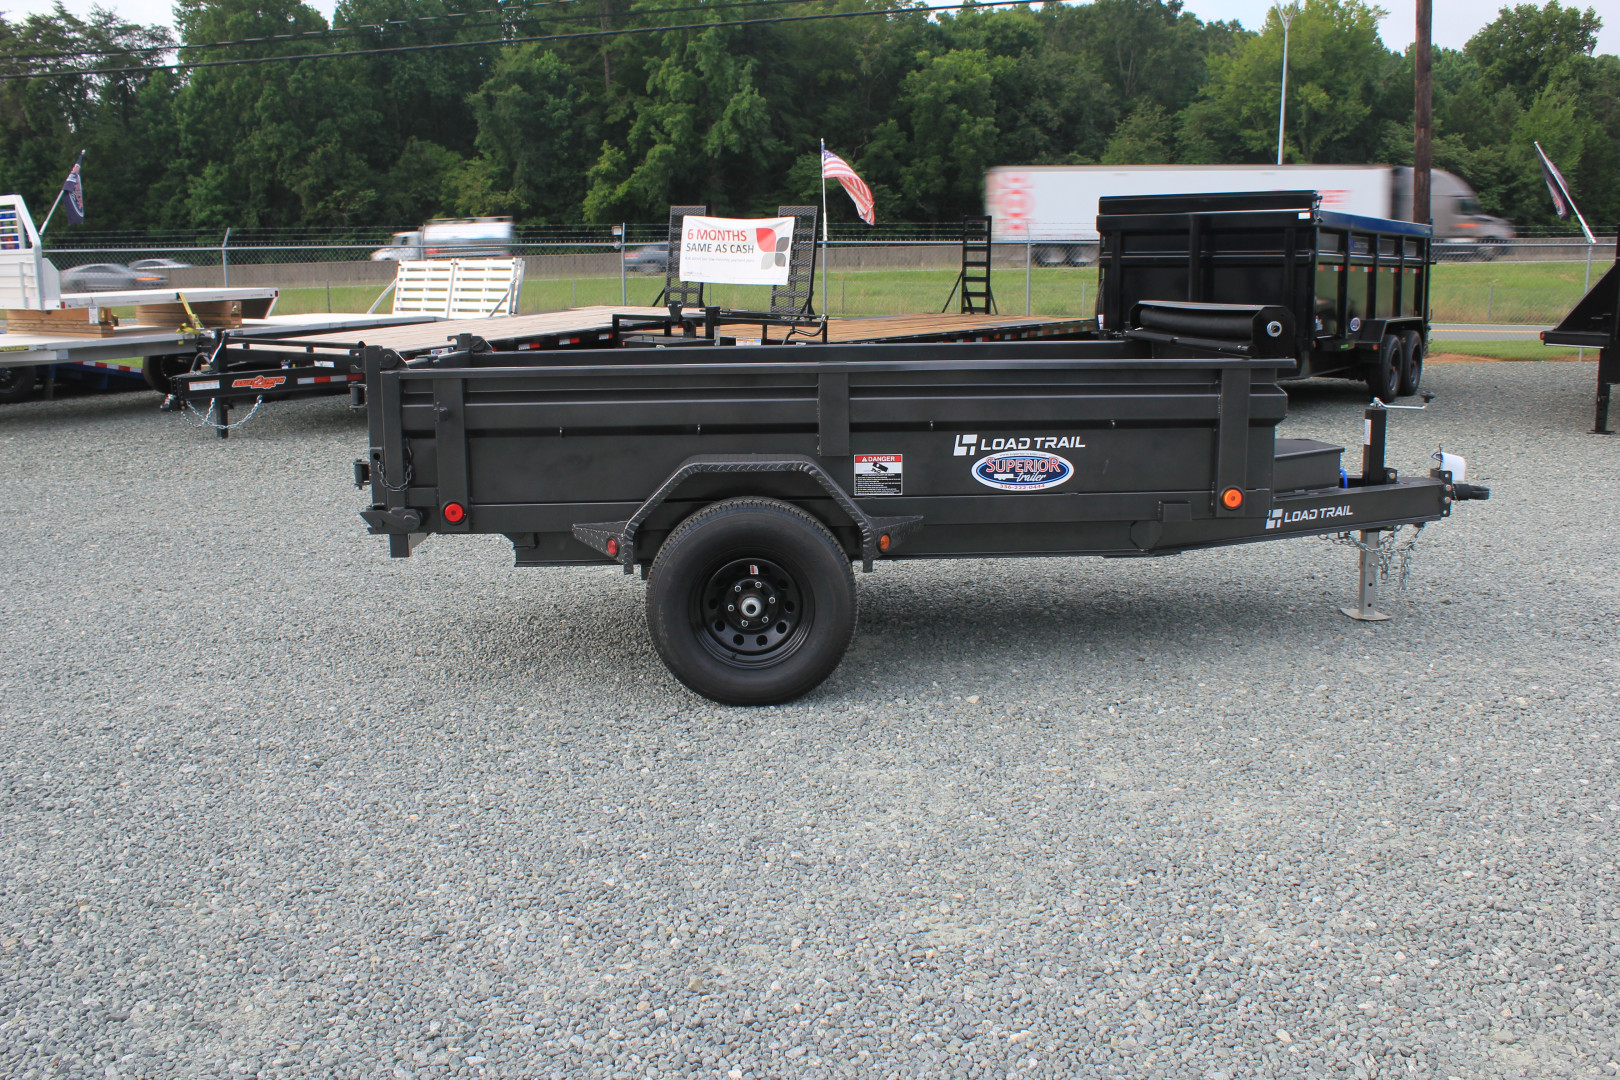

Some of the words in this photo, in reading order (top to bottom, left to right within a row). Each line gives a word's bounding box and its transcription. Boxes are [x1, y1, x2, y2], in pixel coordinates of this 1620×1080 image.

[687, 229, 694, 240] 6
[696, 229, 747, 242] MONTHS
[686, 243, 713, 253] SAME
[715, 243, 727, 253] AS
[730, 244, 754, 254] CASH
[980, 438, 1031, 450] LOAD
[1034, 436, 1086, 449] TRAIL
[986, 456, 1061, 473] SUPERIOR
[1284, 509, 1319, 523] LOAD
[1319, 505, 1354, 519] TRAIL
